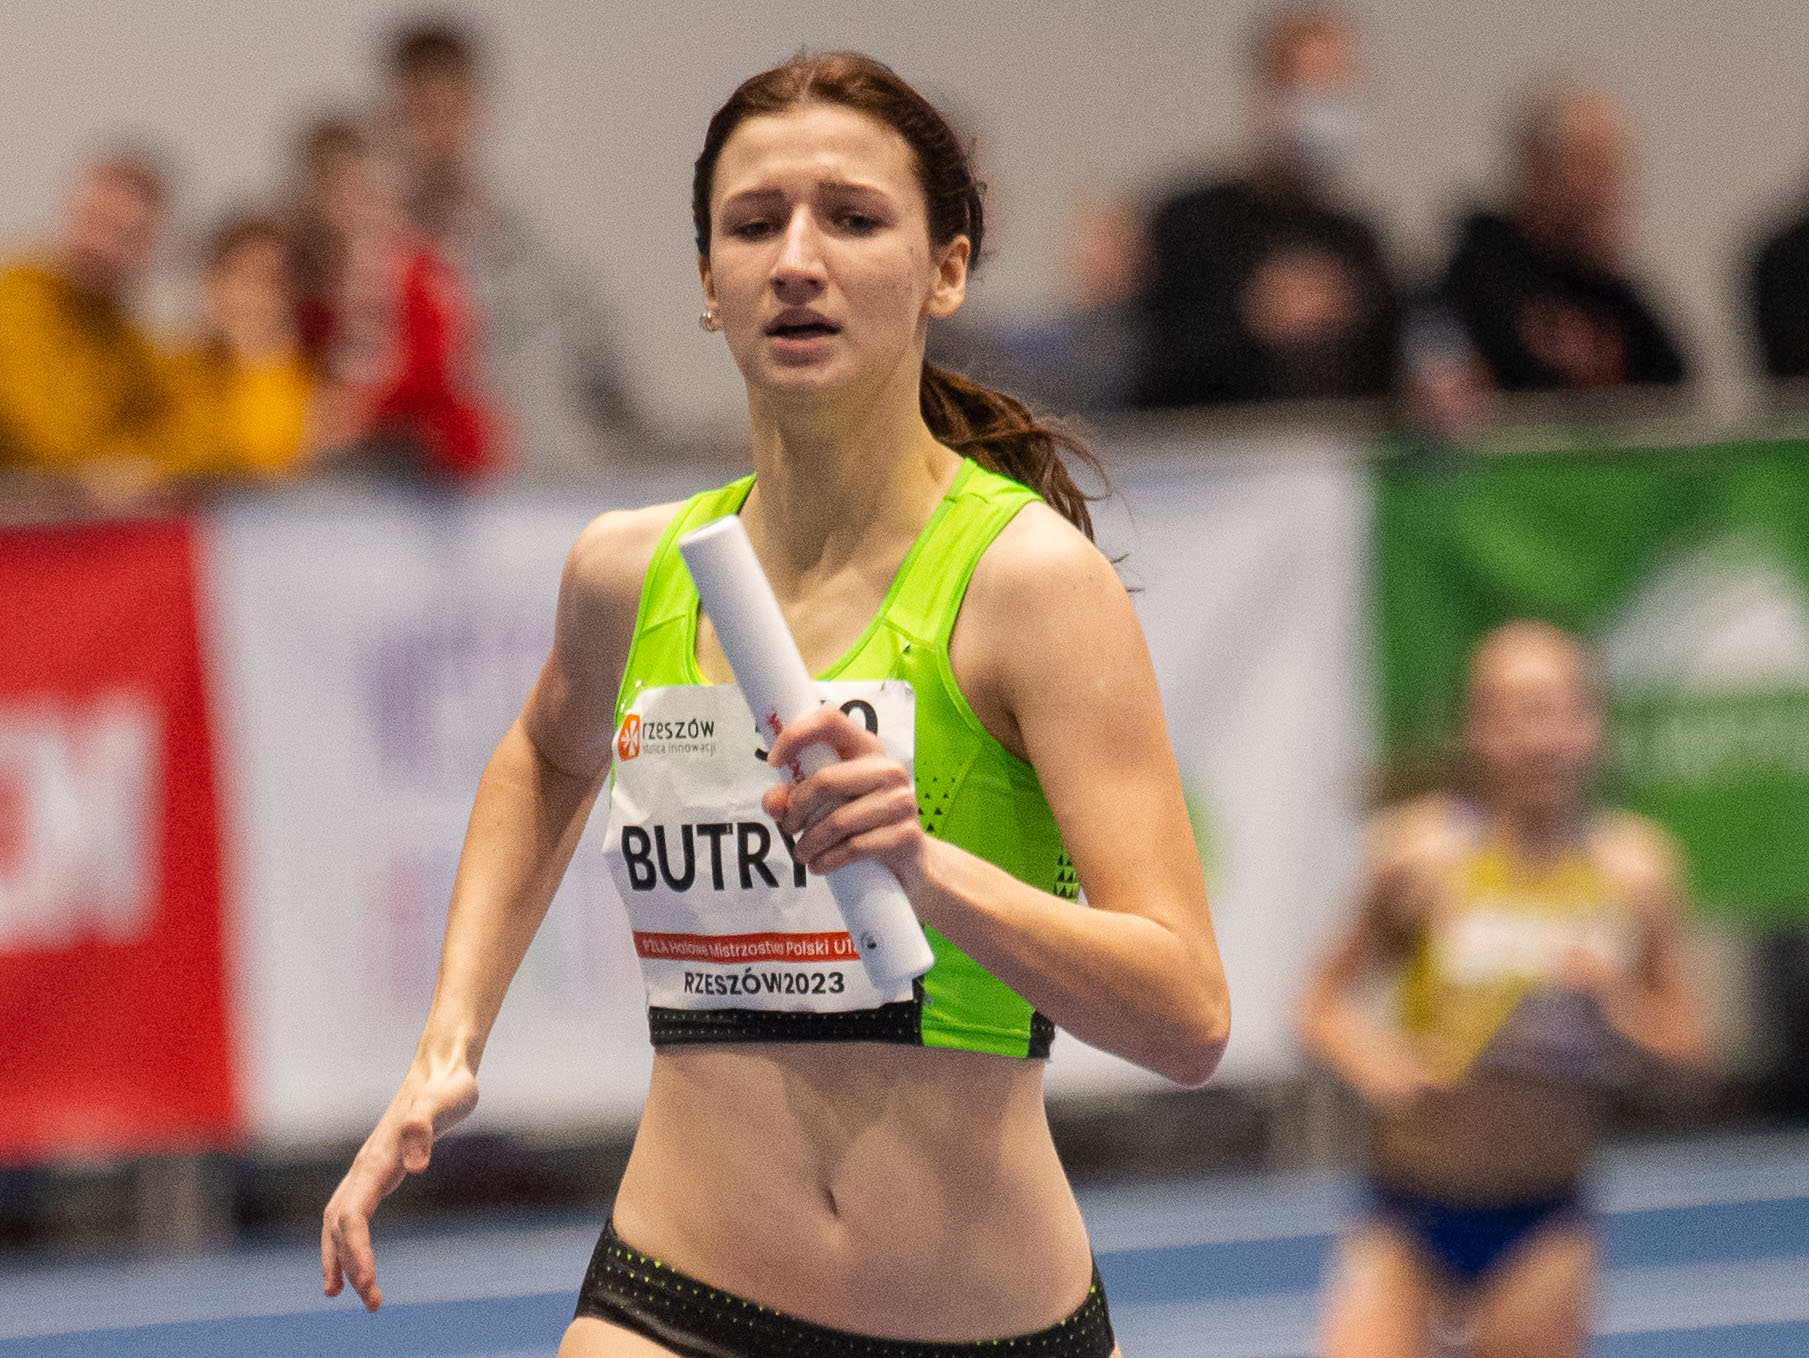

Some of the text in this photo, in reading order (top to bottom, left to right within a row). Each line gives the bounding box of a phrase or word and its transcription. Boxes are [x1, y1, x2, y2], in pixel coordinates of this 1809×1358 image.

[643, 718, 715, 740] rzeszów
[668, 742, 717, 757] innowacji
[621, 821, 807, 893] BUTRY
[709, 941, 784, 958] Mistrzostwa
[786, 940, 829, 956] Polski
[684, 966, 845, 995] RZESZÓW2023
